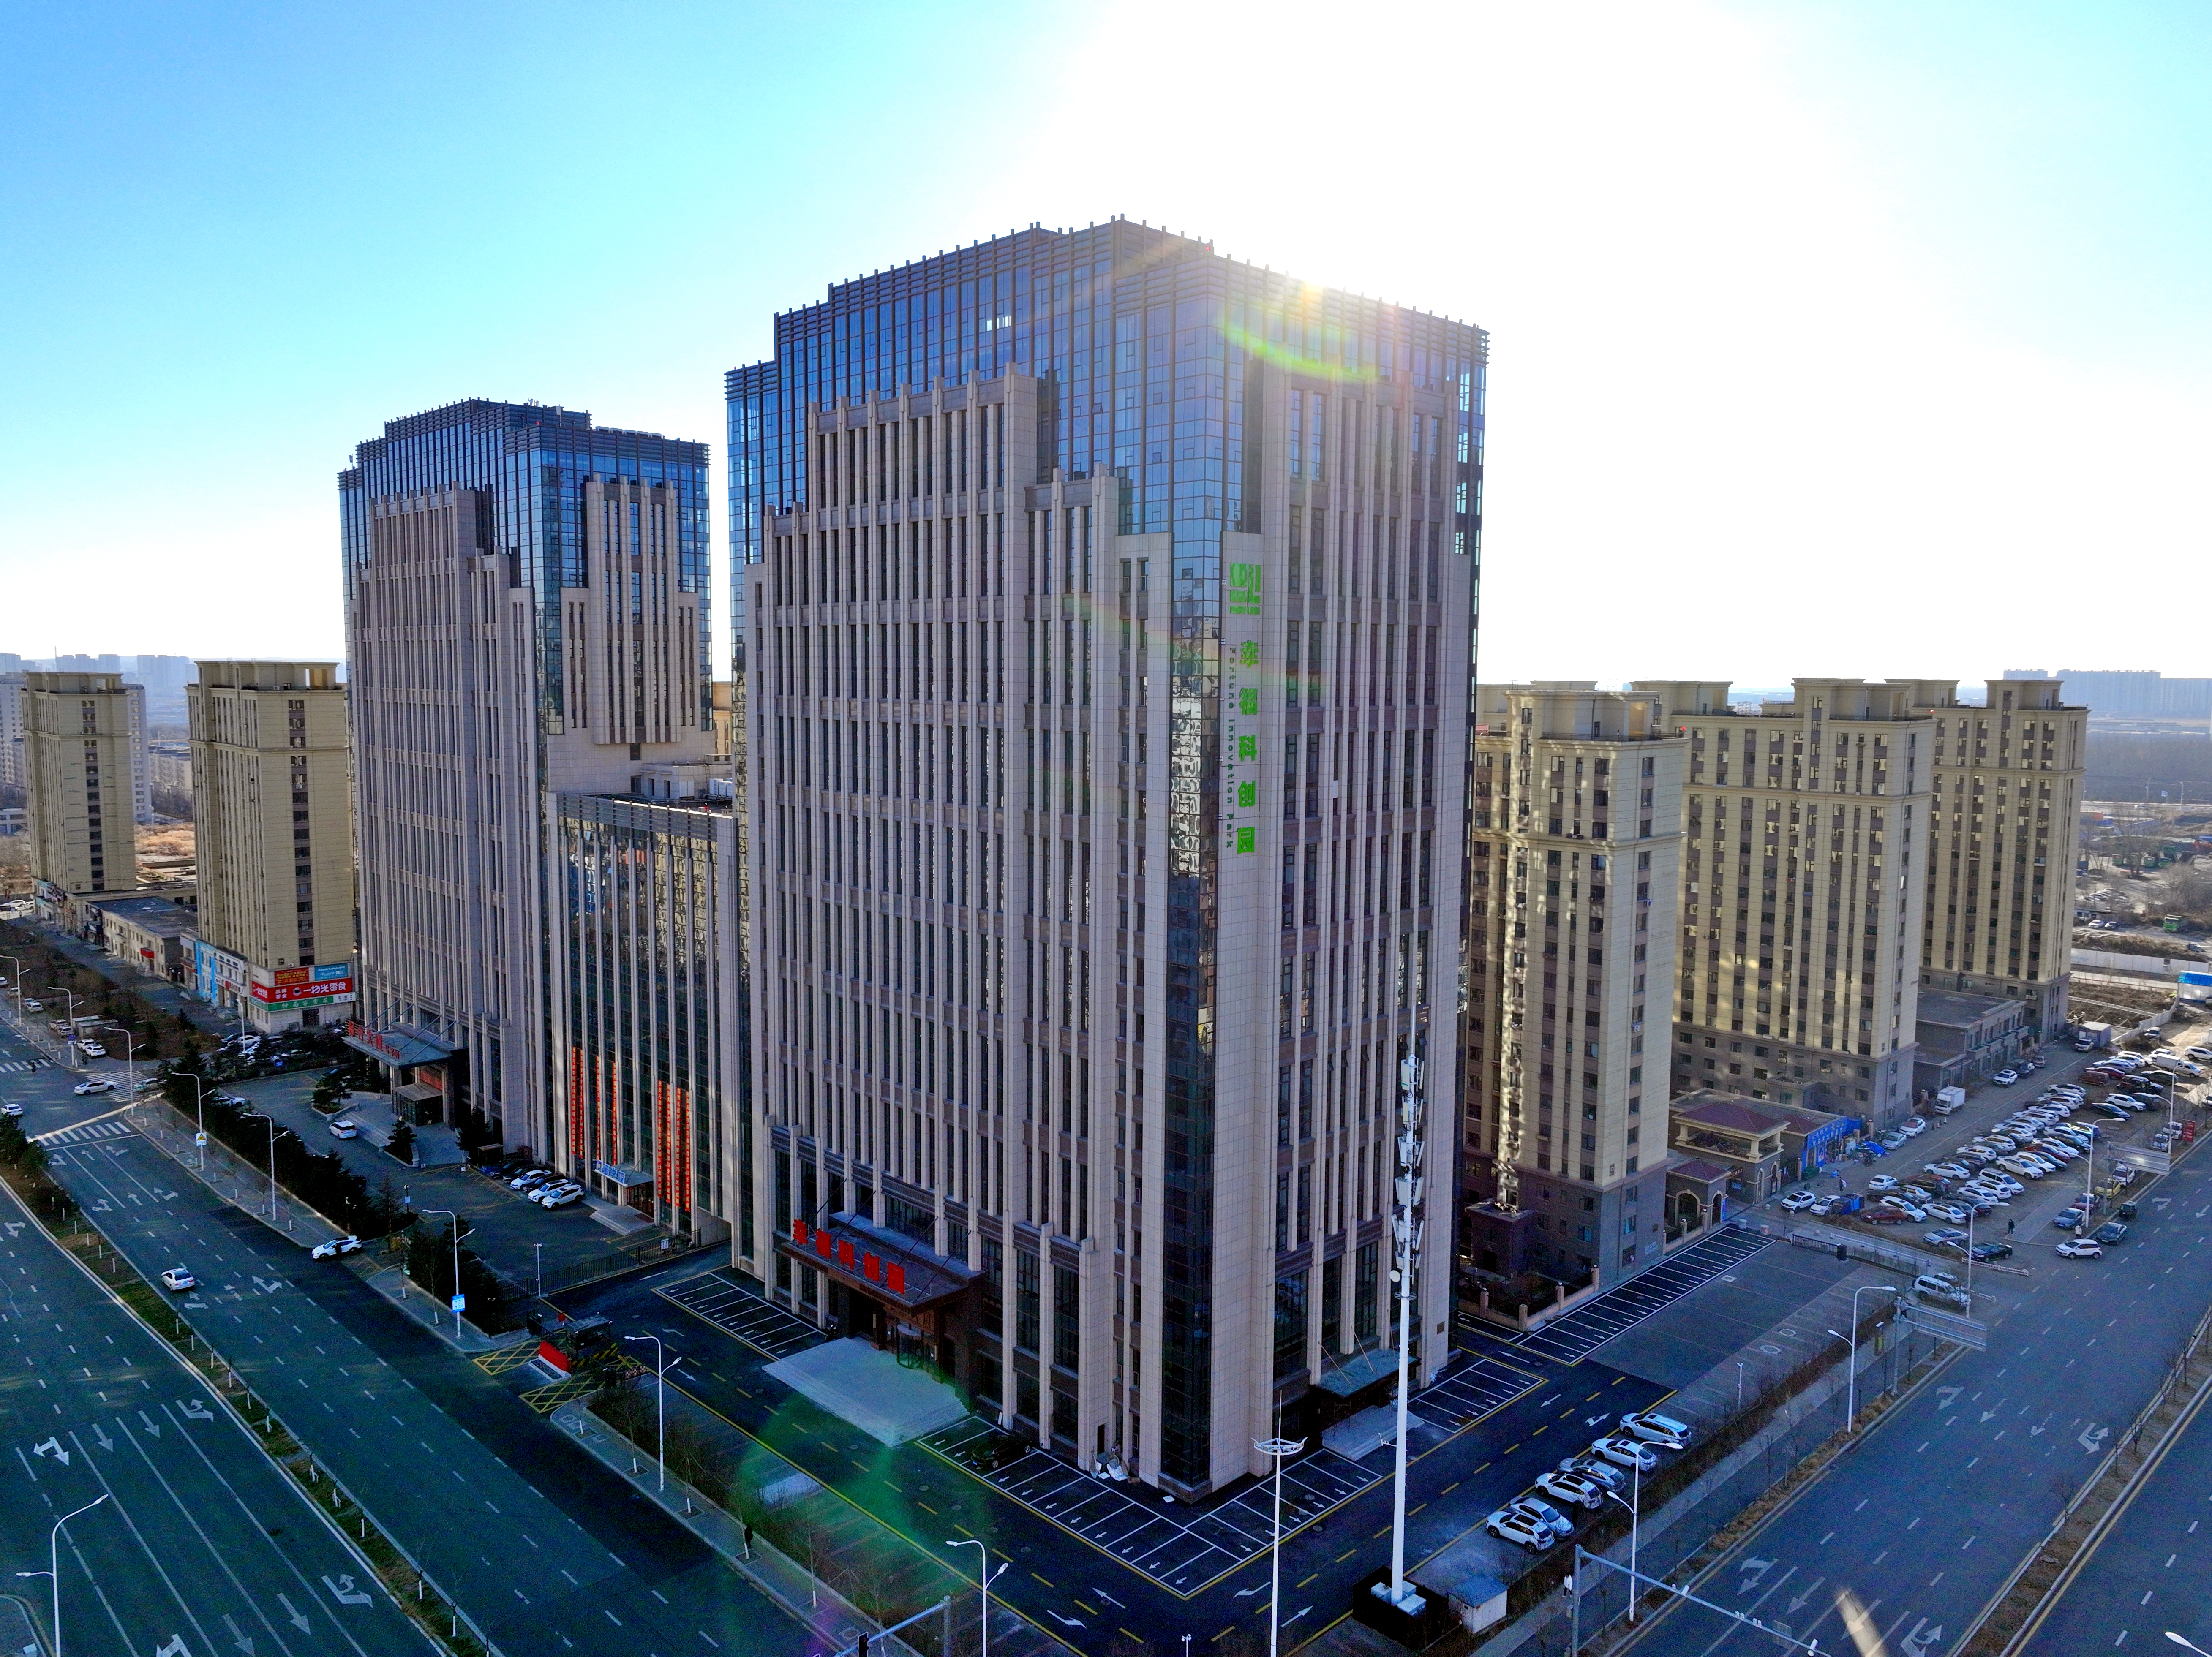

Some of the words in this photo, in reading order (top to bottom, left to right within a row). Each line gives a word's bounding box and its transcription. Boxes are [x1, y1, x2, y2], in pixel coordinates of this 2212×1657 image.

[1227, 719, 1235, 803] Innovation
[1237, 640, 1259, 855] 幸福科创园
[303, 981, 346, 994] 一扫光零食
